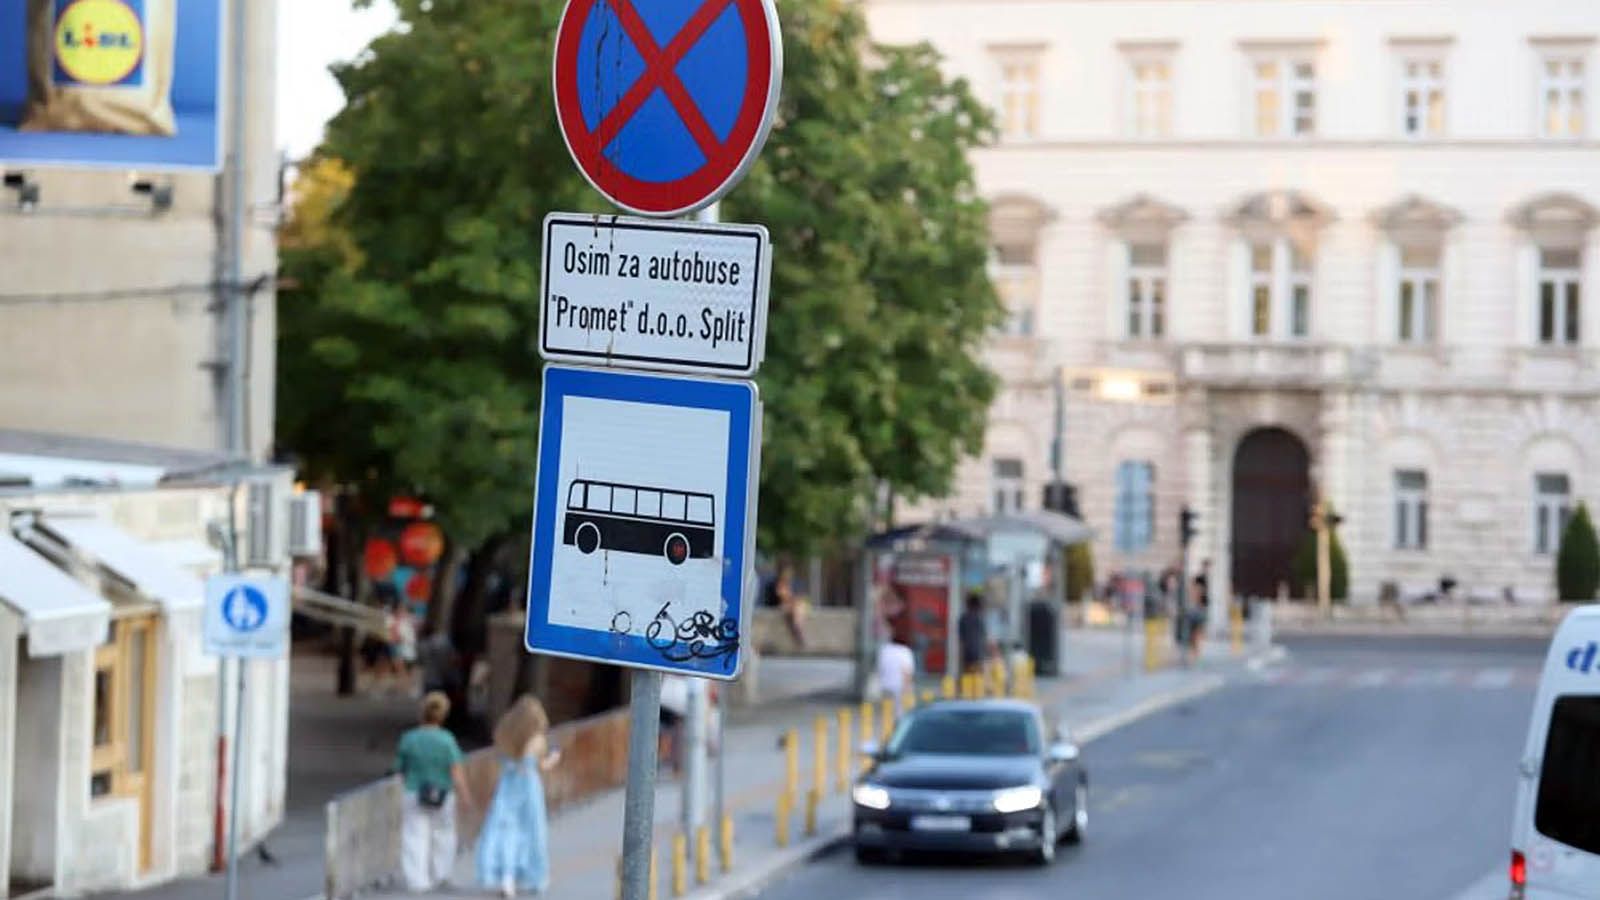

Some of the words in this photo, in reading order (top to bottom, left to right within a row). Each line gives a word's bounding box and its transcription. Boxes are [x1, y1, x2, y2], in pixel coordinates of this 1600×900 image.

[563, 241, 610, 275] Osim
[618, 253, 640, 278] za
[648, 250, 740, 286] autobuse
[551, 294, 634, 332] "Promet"
[637, 303, 694, 338] d.o.o.
[700, 307, 746, 348] Split
